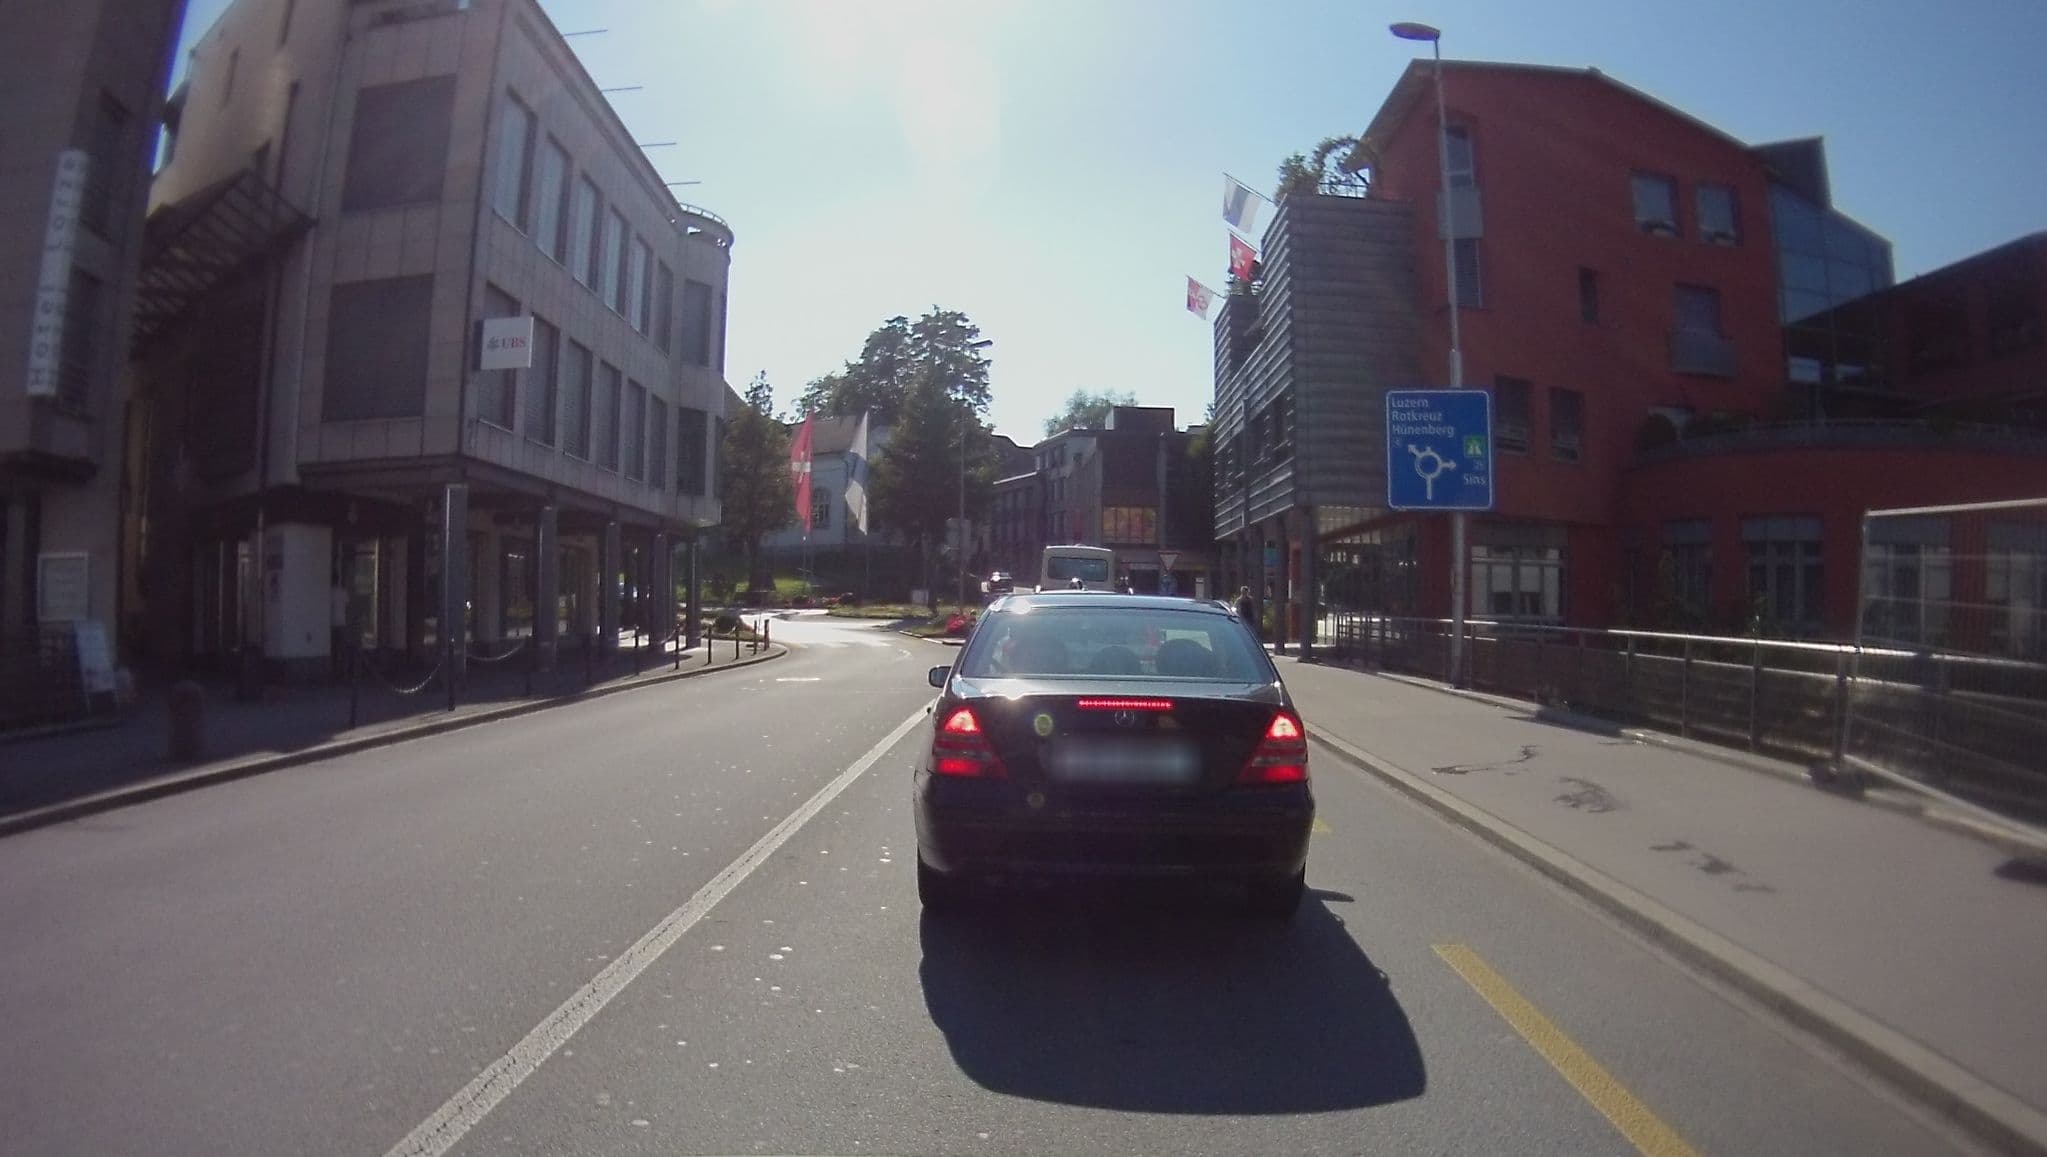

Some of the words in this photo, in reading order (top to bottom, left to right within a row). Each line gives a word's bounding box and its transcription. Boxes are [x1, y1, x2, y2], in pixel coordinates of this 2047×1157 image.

[1391, 397, 1429, 408] Luzern
[1391, 410, 1442, 422] Rotkreuz
[1392, 424, 1455, 438] Hünenberg
[1463, 473, 1487, 486] Sins
